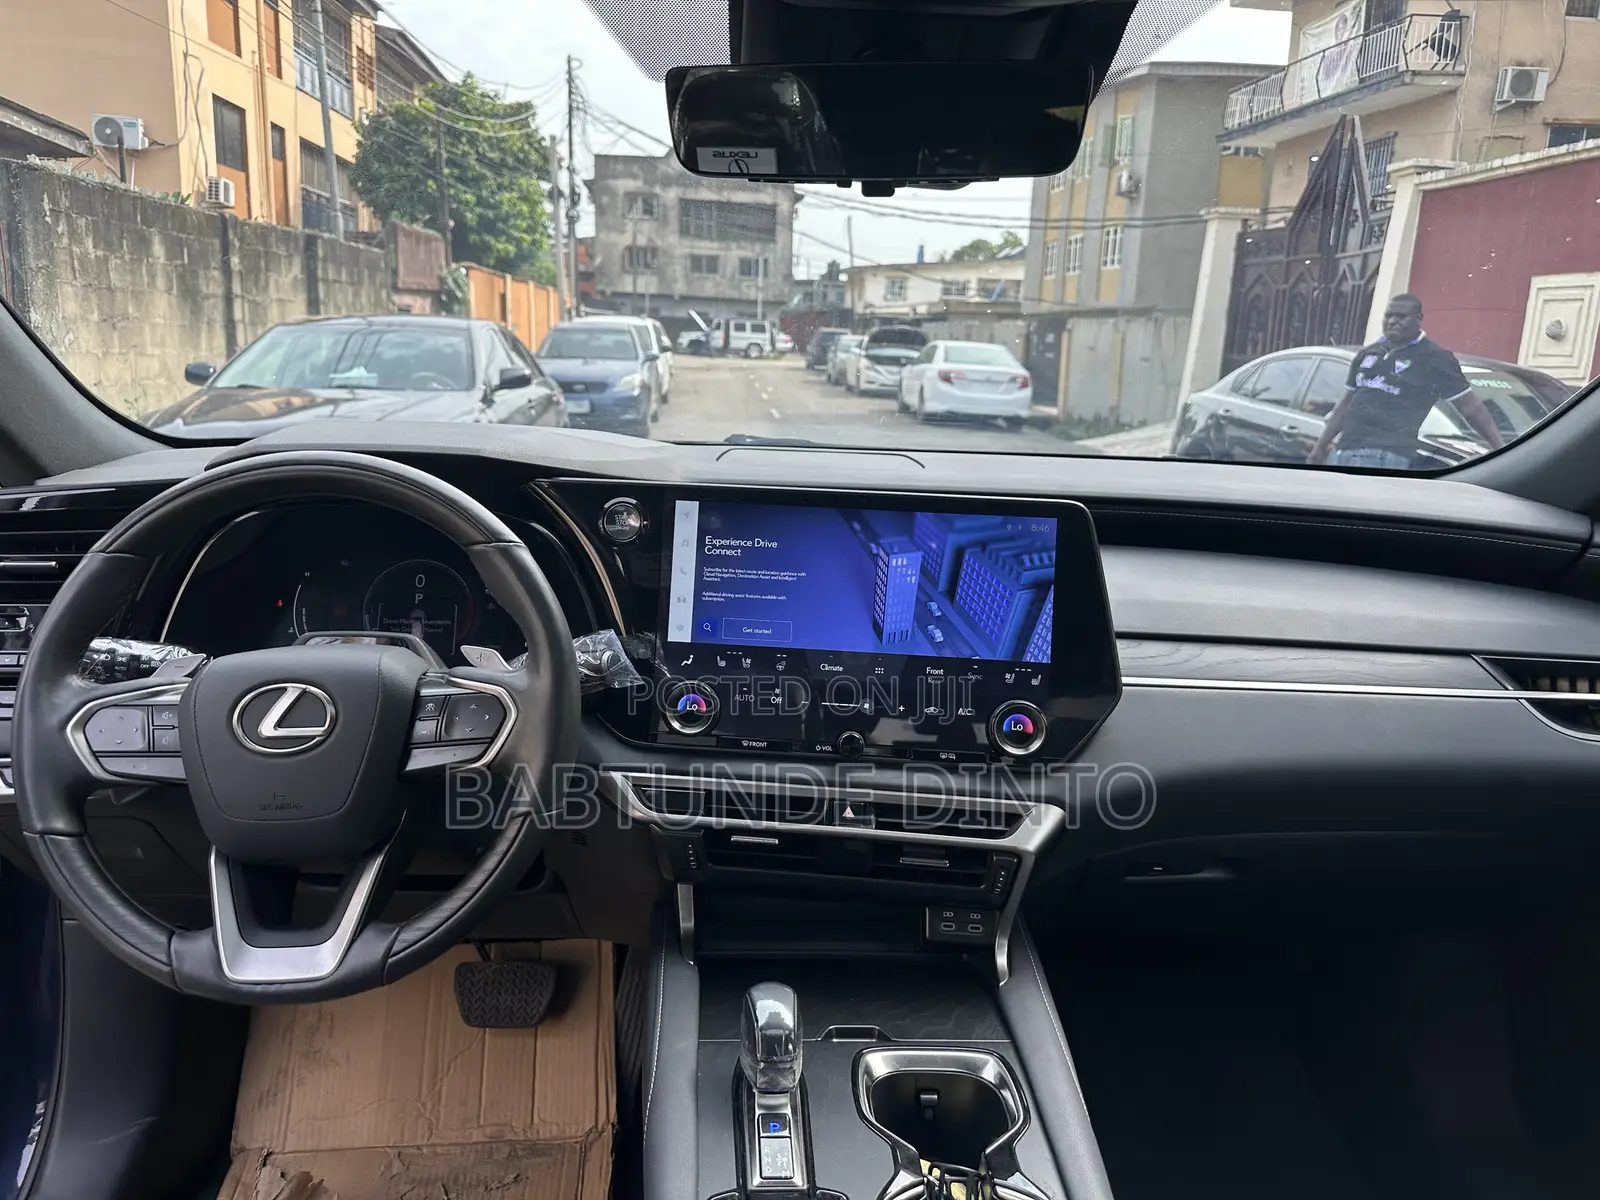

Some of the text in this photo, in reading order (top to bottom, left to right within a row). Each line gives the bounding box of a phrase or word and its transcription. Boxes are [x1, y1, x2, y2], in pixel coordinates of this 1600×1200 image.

[1031, 523, 1050, 532] 8:46
[705, 535, 778, 548] Experience Drive
[704, 545, 742, 556] Connect
[820, 663, 844, 672] Climate
[926, 666, 944, 675] Front
[734, 694, 755, 702] AUTO
[770, 696, 782, 704] Off
[686, 701, 698, 711] Lo
[1011, 720, 1024, 731] Lo
[769, 1122, 781, 1135] P
